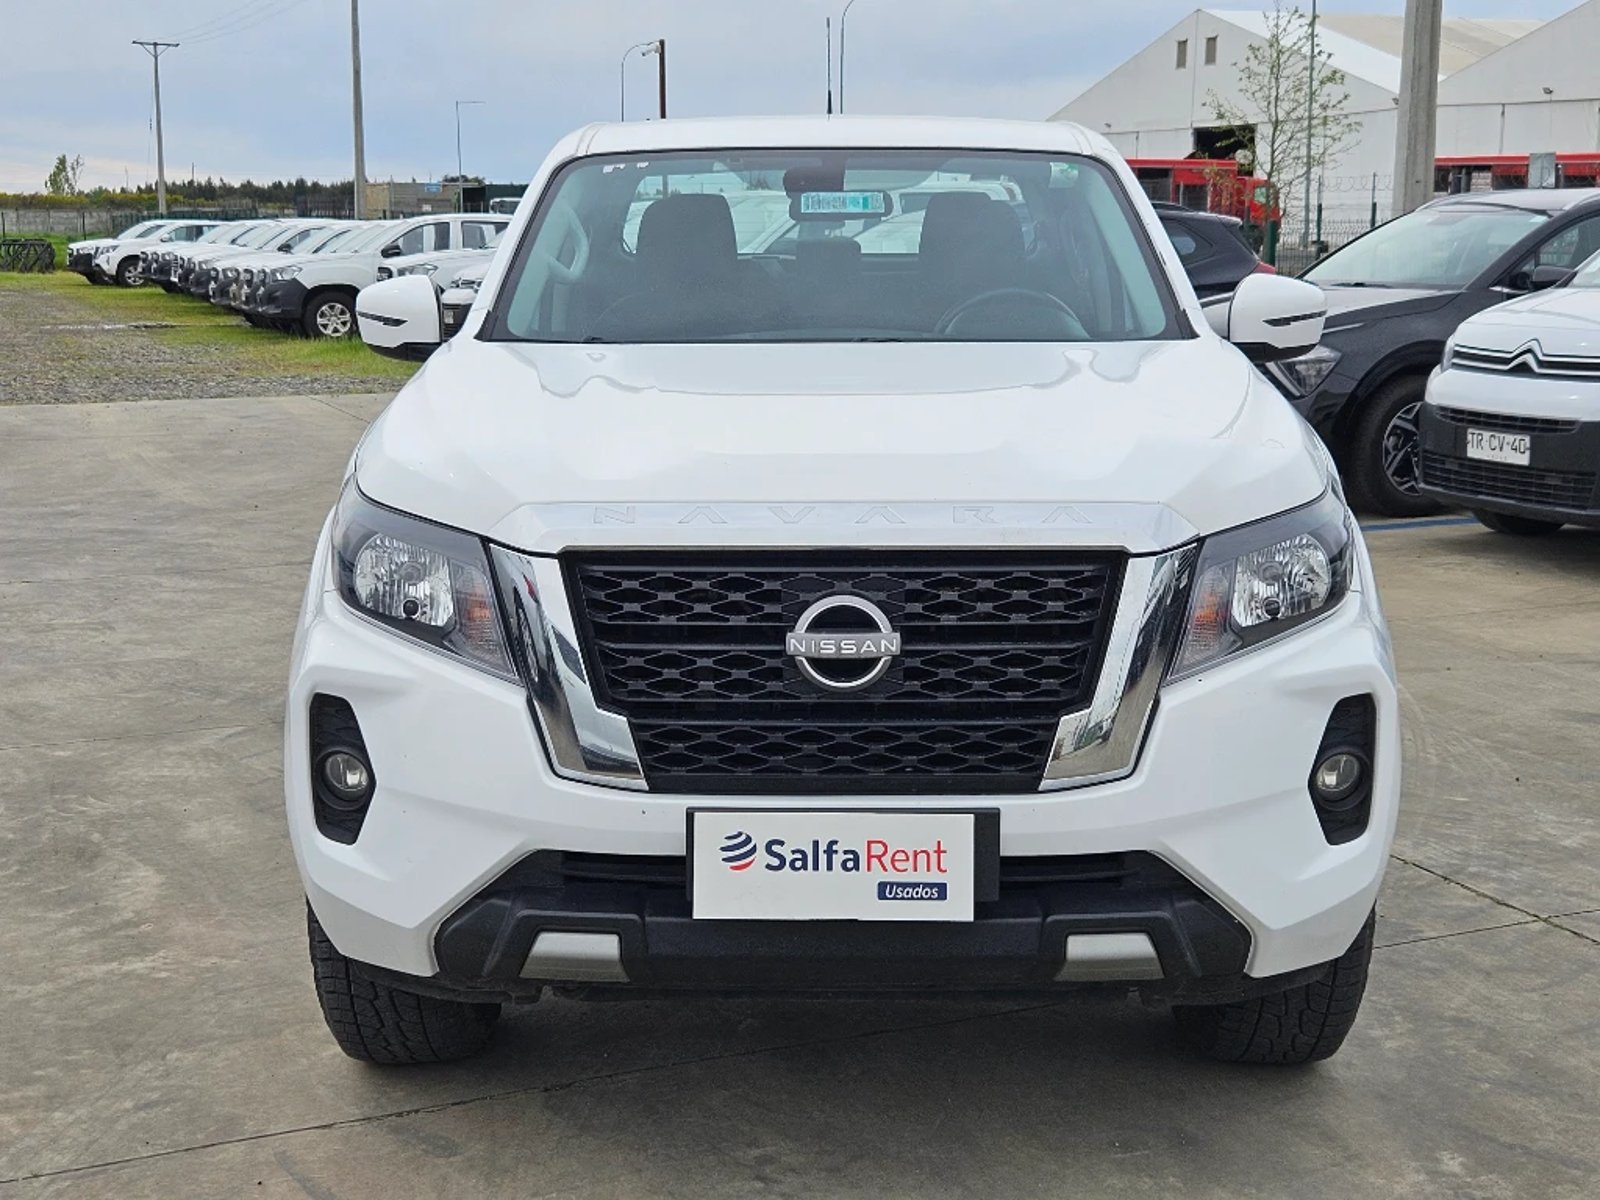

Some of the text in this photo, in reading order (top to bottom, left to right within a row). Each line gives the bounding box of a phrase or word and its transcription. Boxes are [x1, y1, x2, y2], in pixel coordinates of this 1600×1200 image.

[593, 505, 1093, 524] NAVARA
[790, 639, 897, 653] NISSAN
[764, 838, 948, 873] SalfaRent
[885, 884, 939, 899] Usados
